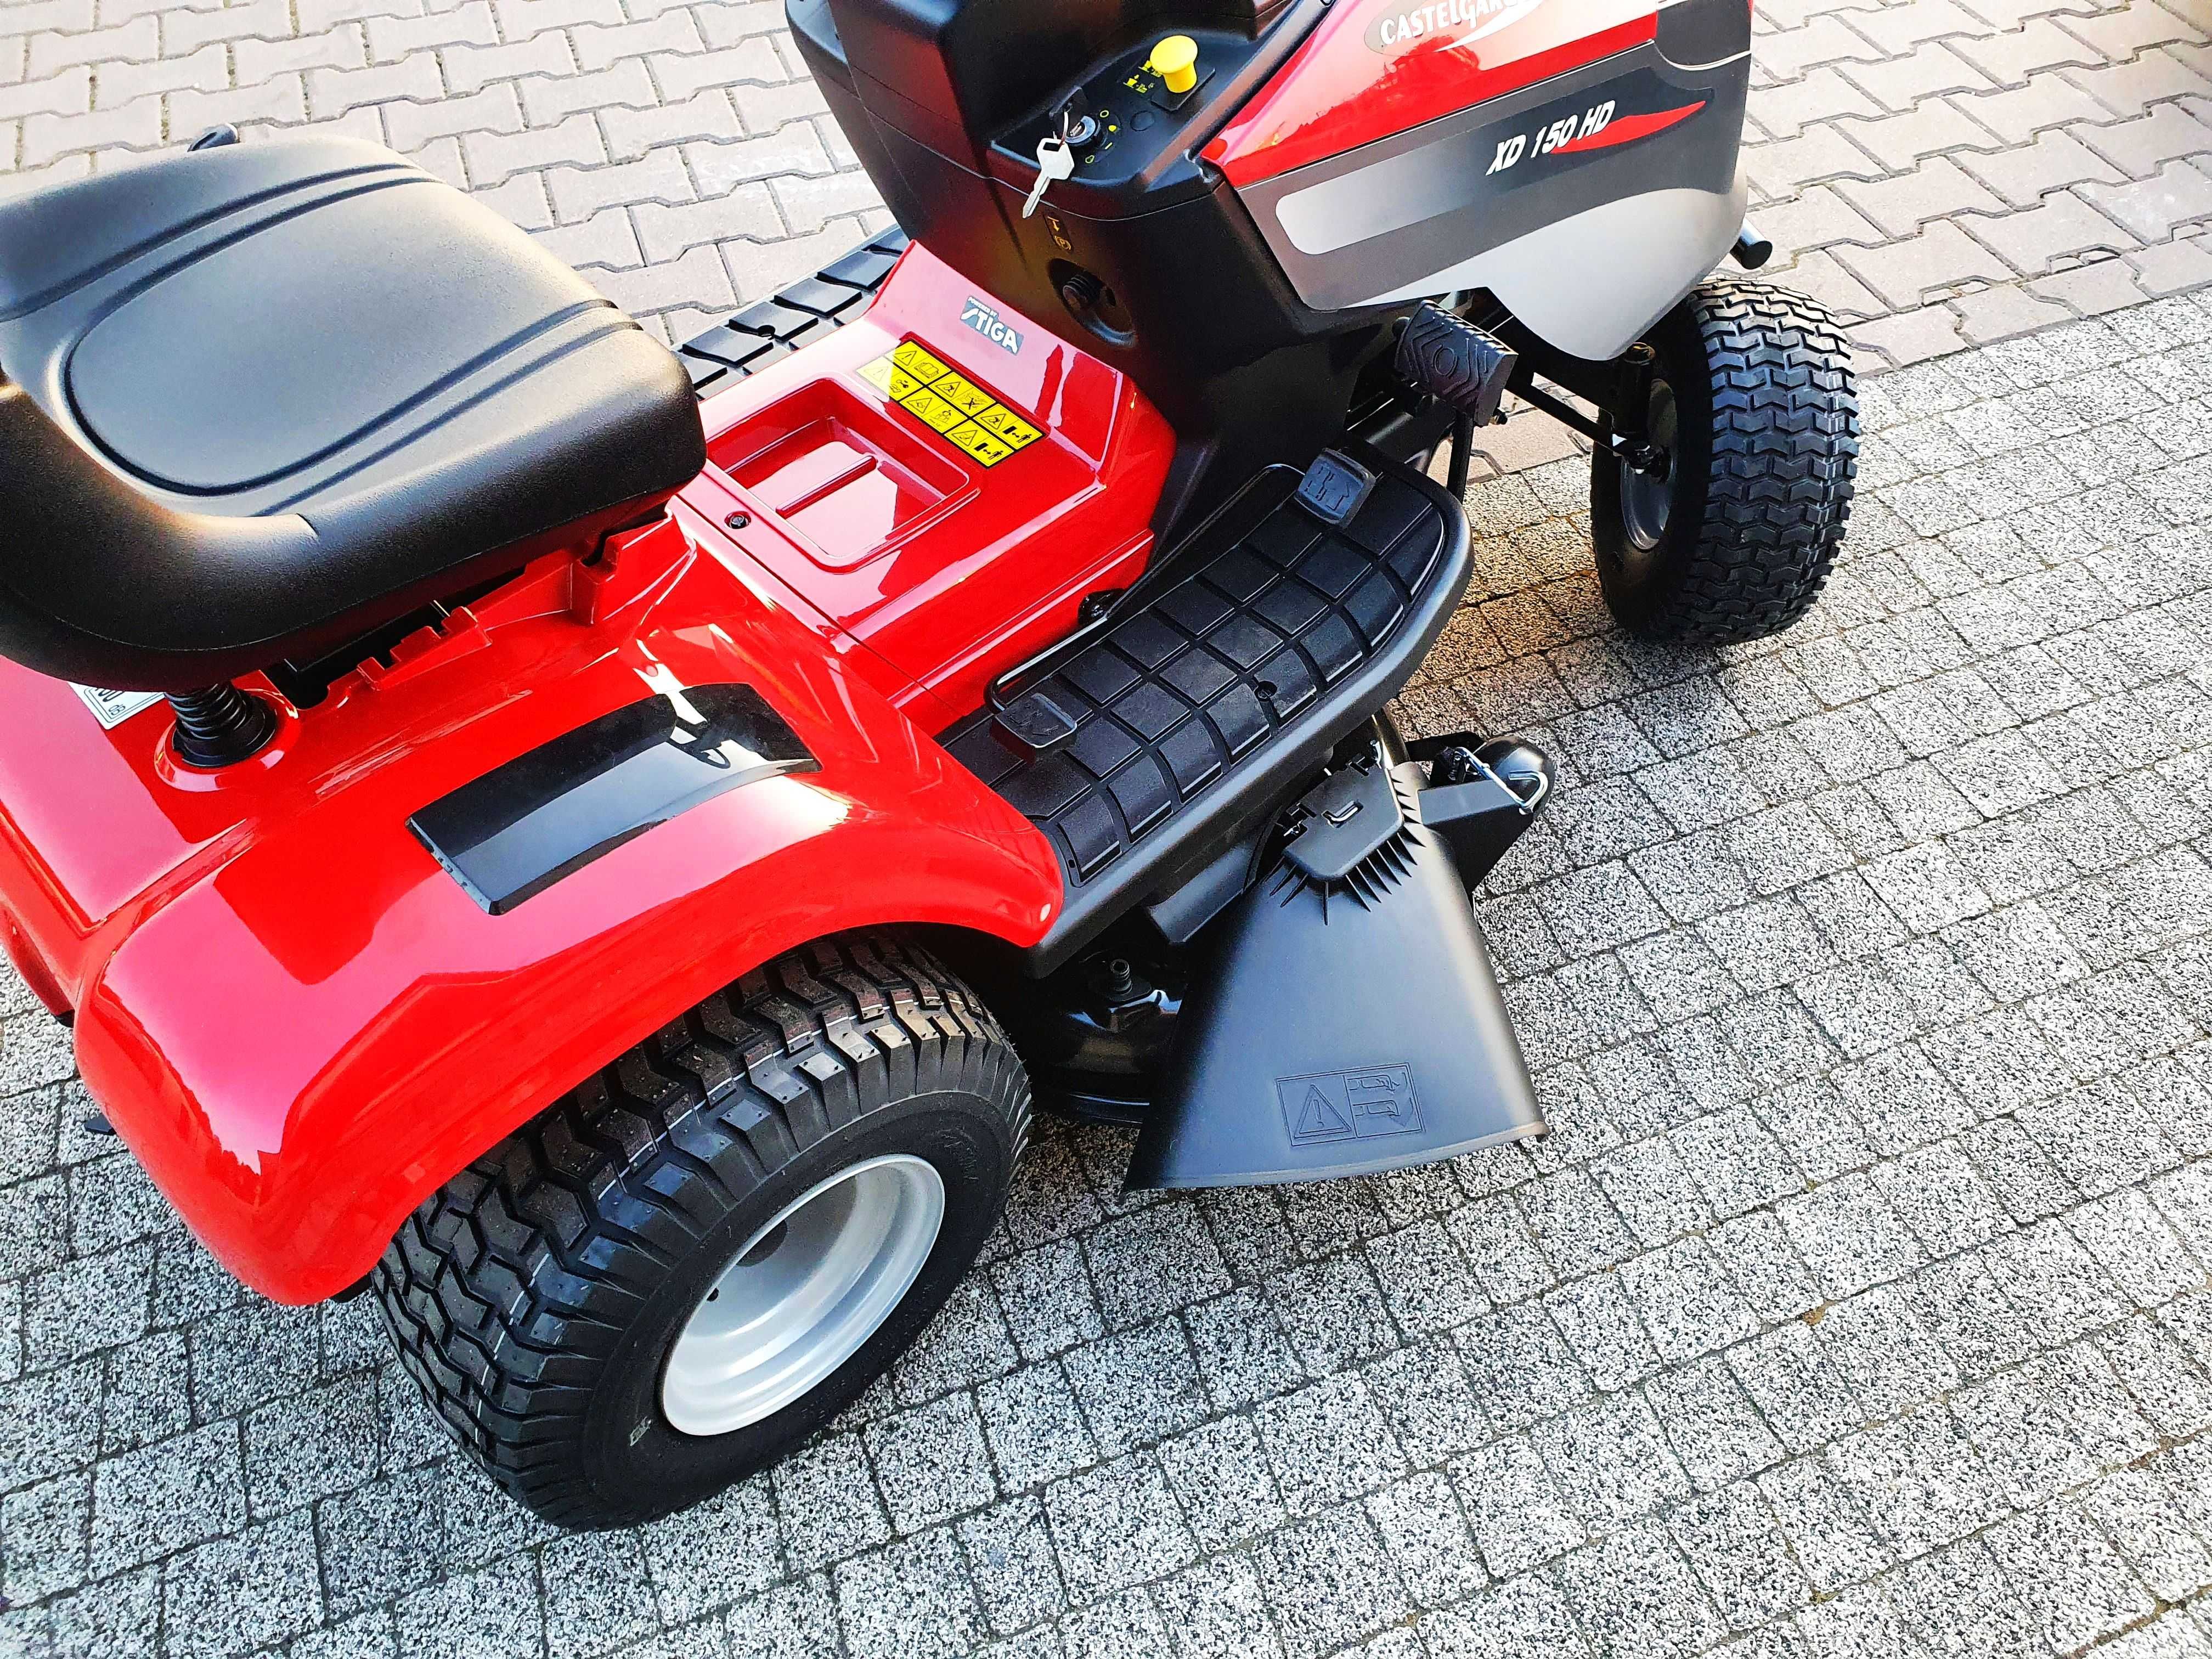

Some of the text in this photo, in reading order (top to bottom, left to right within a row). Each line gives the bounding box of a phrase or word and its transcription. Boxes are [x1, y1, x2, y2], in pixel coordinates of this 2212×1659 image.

[1485, 100, 1616, 176] XD 150 HD
[961, 307, 1019, 354] STIGA
